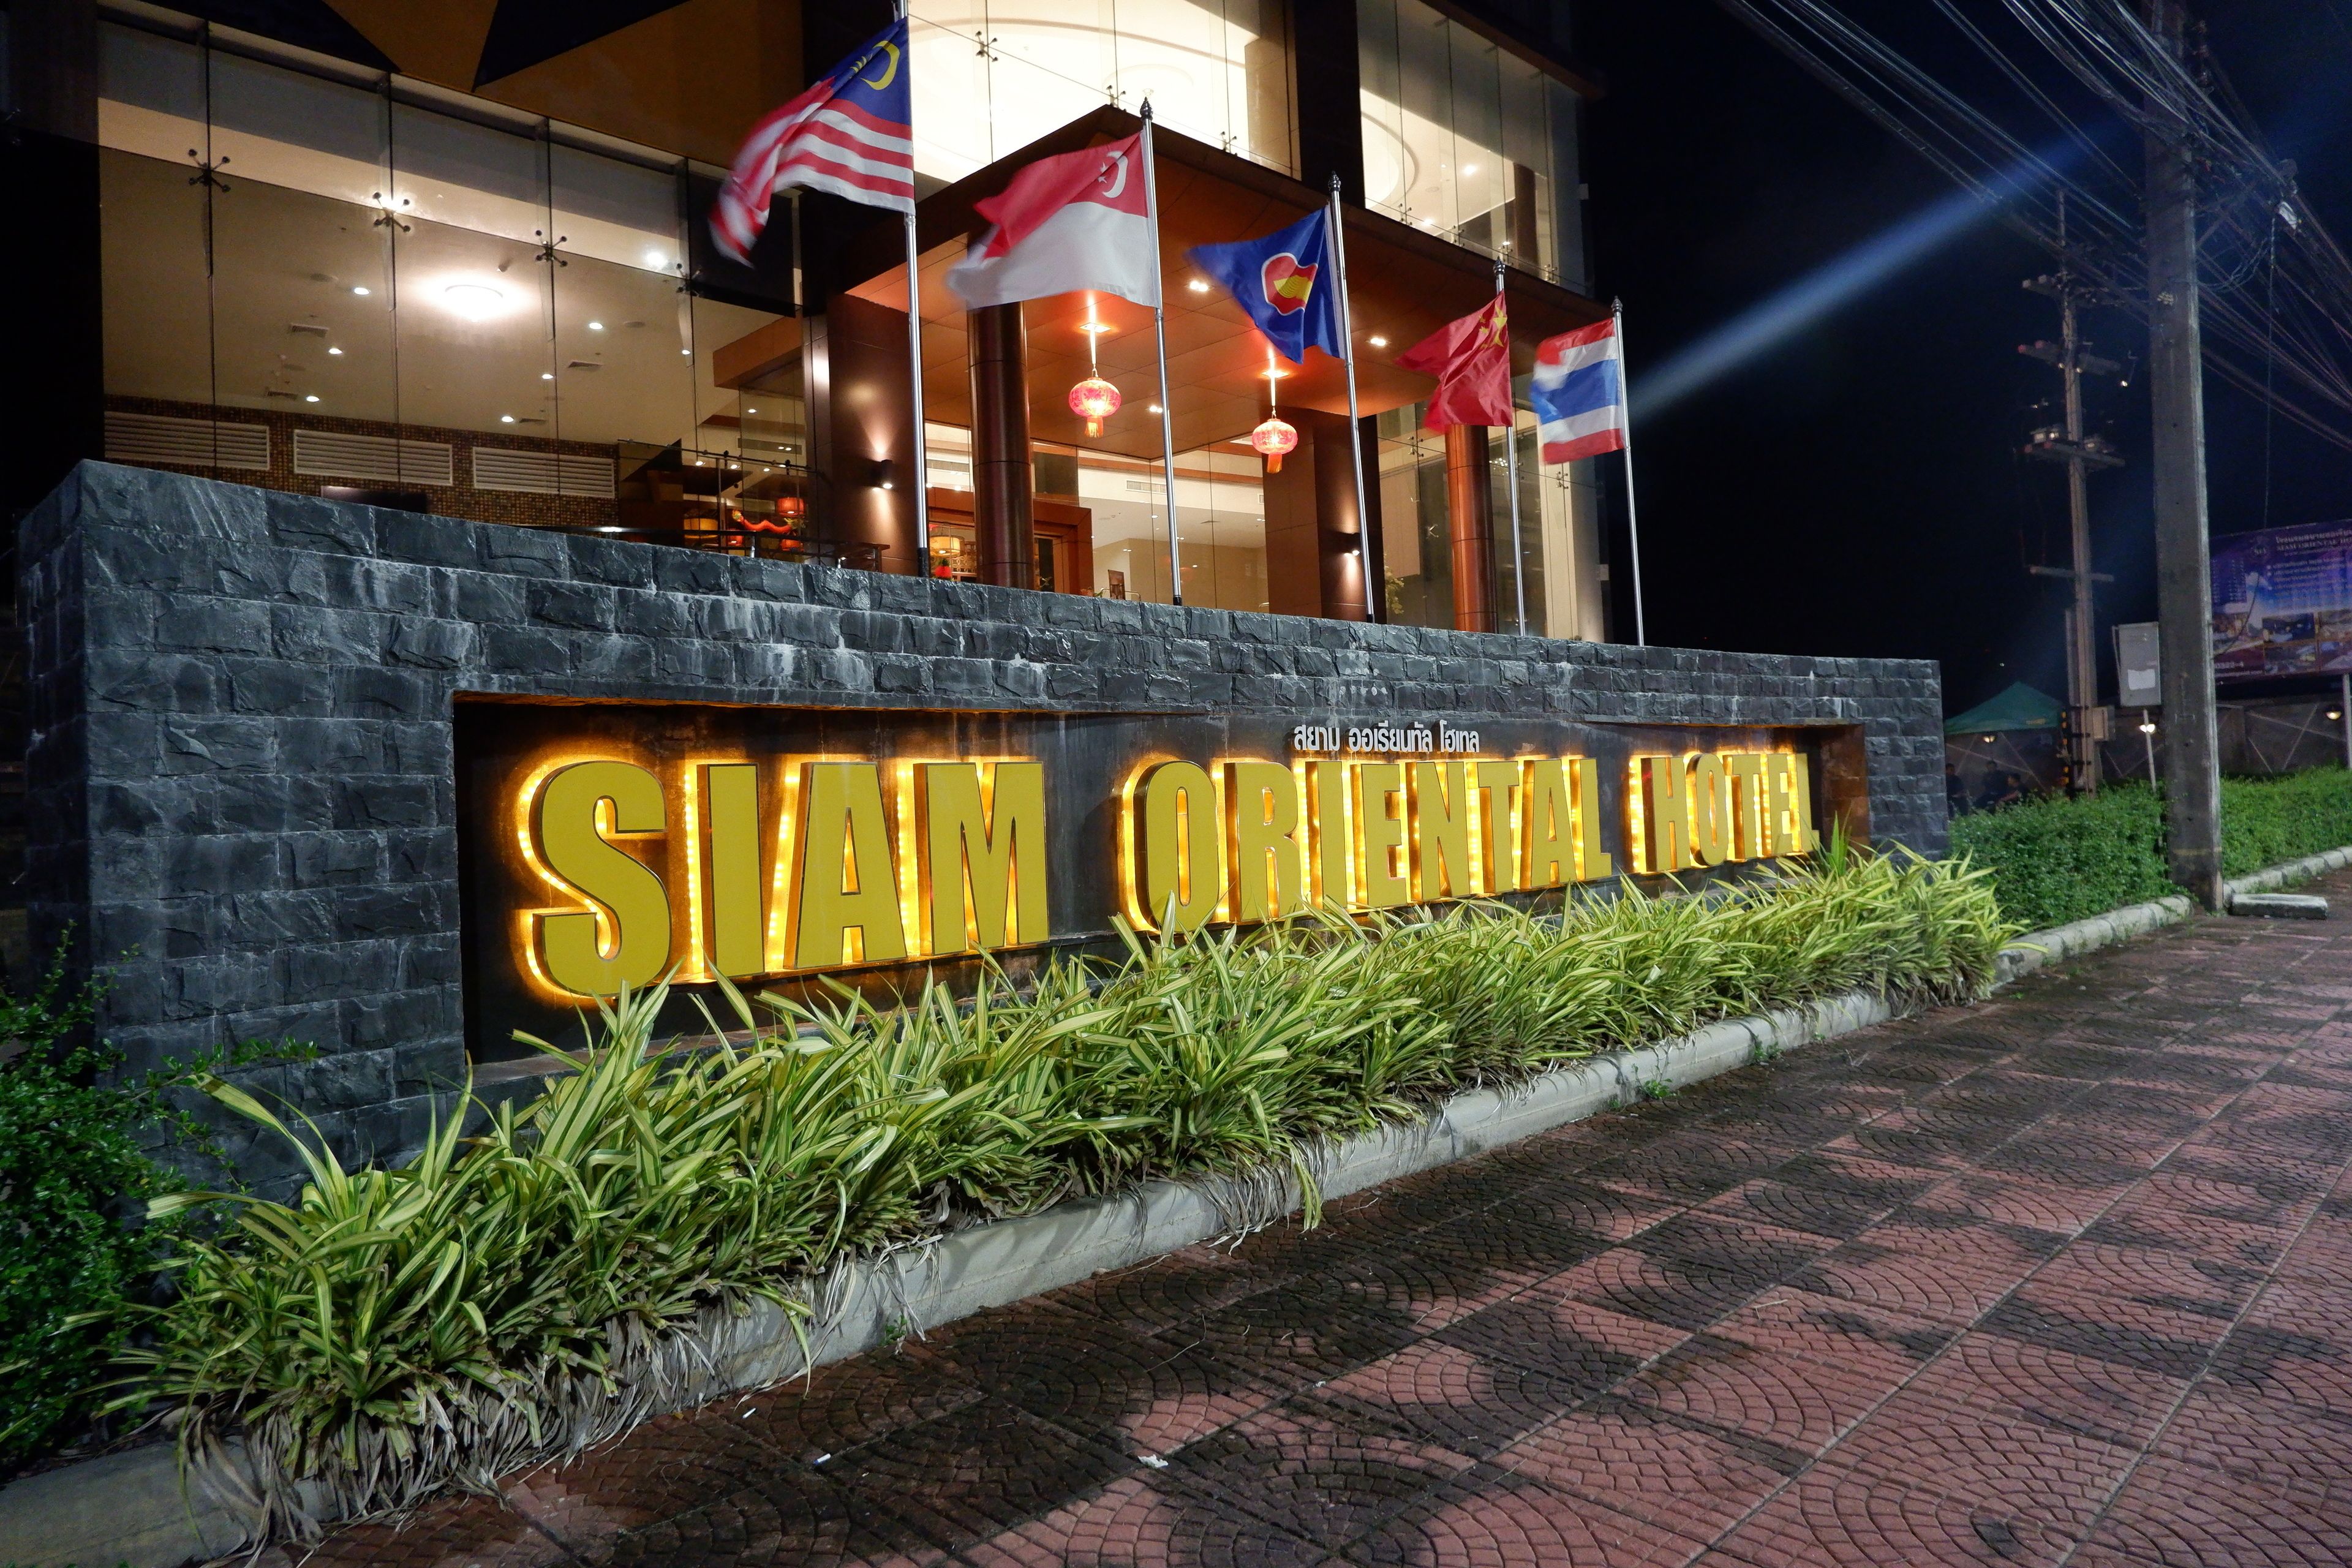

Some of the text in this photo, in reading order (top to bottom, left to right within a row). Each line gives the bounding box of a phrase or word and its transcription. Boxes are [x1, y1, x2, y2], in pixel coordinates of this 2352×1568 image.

[1294, 719, 1480, 753] สยาม ออเรียนทัล โฮเทล
[532, 753, 1820, 997] SIAM ORIENTAL HOTEL
